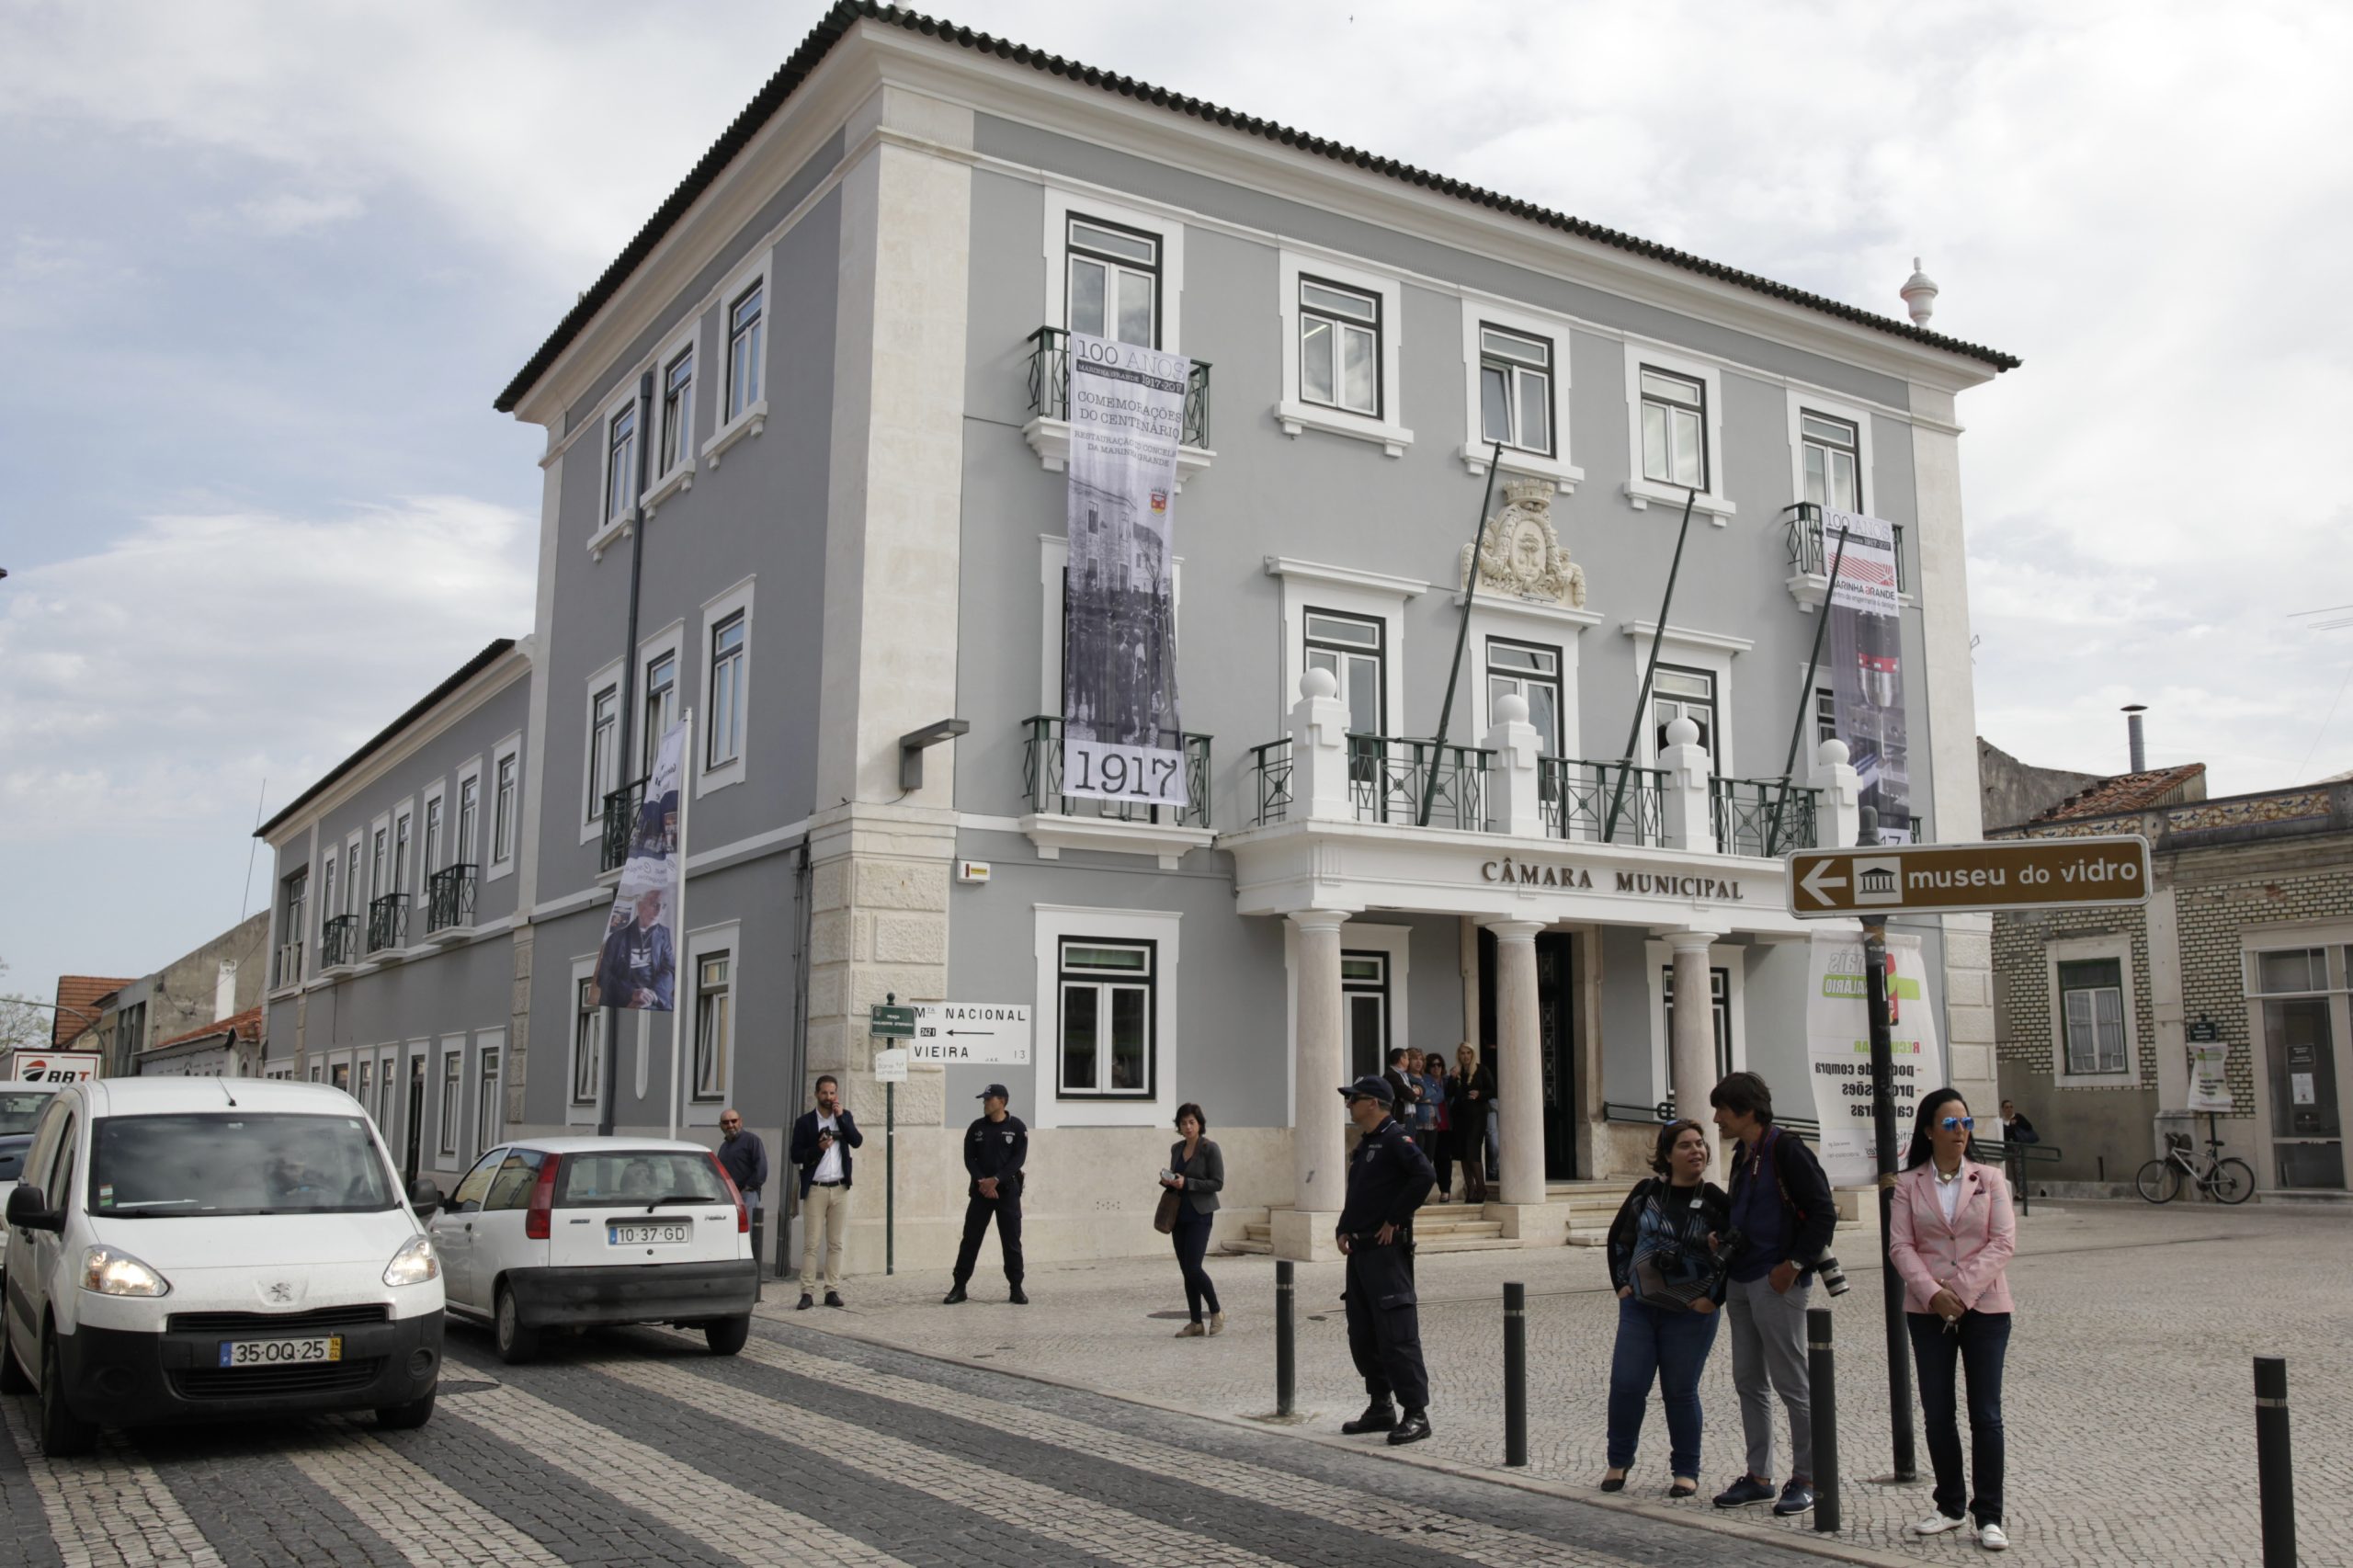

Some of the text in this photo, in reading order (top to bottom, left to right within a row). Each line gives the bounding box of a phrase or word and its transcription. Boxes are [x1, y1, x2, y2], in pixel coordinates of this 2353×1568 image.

[1078, 339, 1185, 381] 100 ANOS
[1077, 391, 1182, 423] COMEMORAÇÕES
[1080, 408, 1180, 439] DO CENTENÁRIO
[1087, 443, 1099, 451] DA
[1137, 454, 1170, 467] GRANDE
[1825, 512, 1850, 529] 100
[1854, 520, 1891, 540] ANOS
[1834, 580, 1895, 600] ARINHA GRANDE
[1074, 750, 1177, 798] 1917
[1481, 857, 1744, 900] CÂMARA MUNICIPAL
[1908, 857, 2138, 889] museu do vidro
[945, 1007, 1027, 1021] NACIONAL
[914, 1045, 969, 1058] VIEIRA
